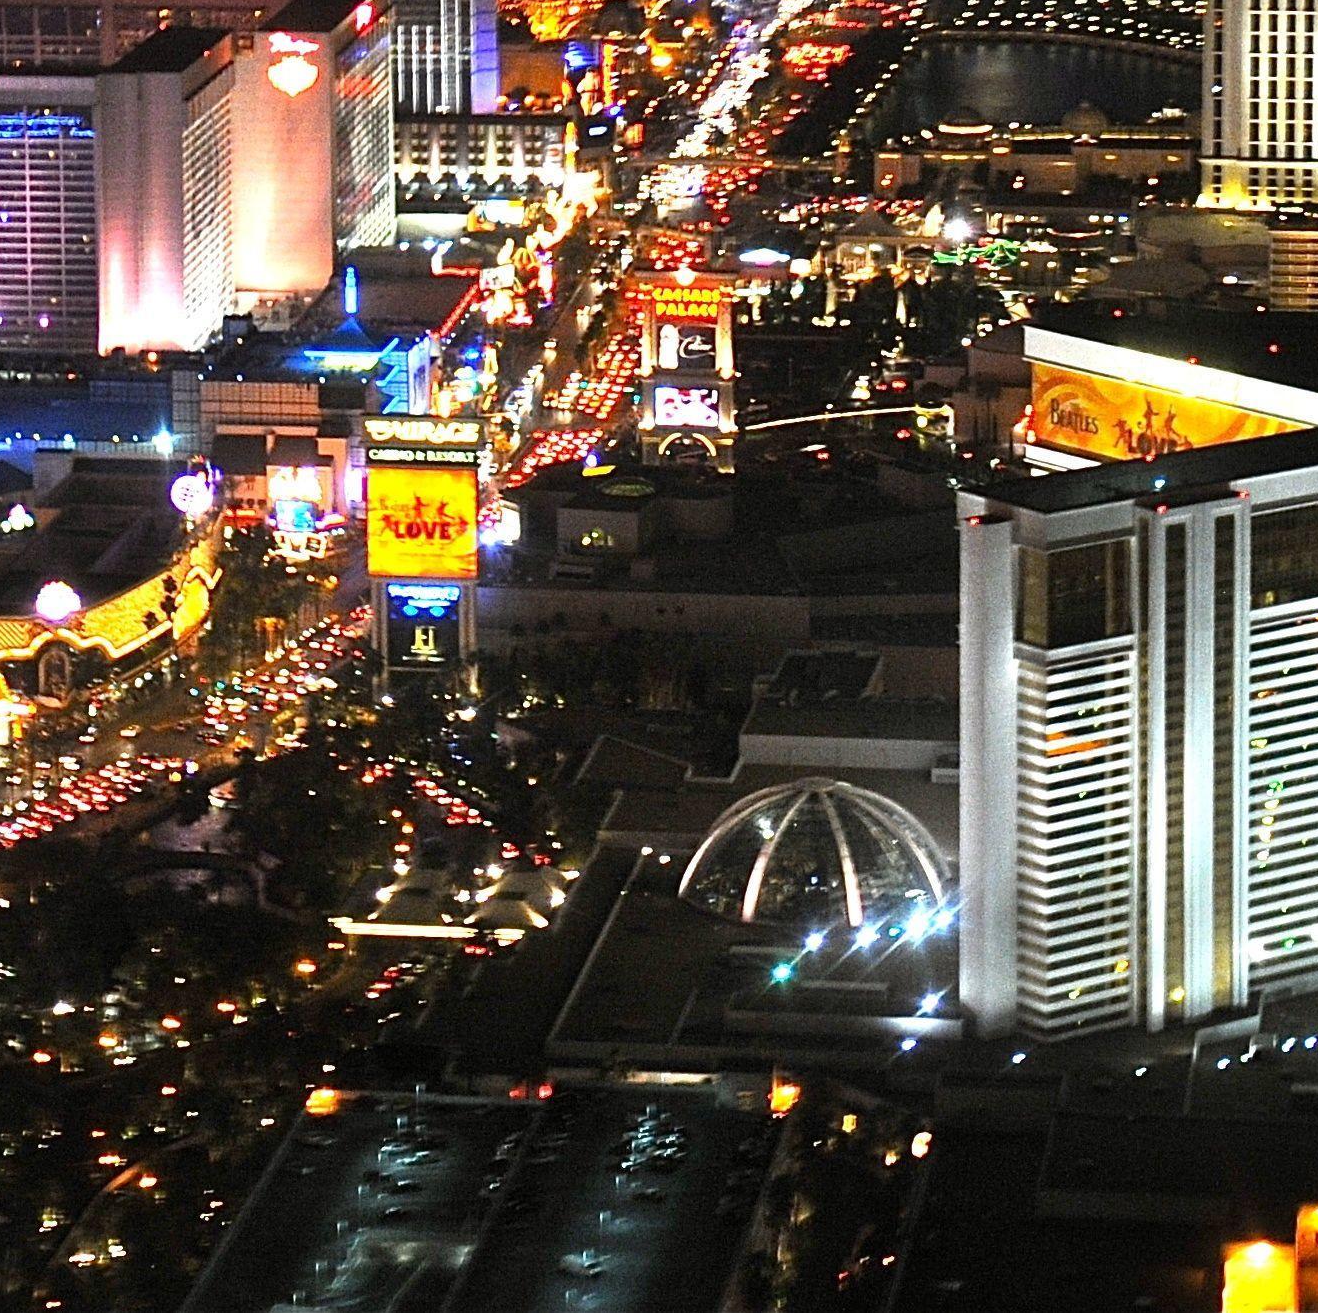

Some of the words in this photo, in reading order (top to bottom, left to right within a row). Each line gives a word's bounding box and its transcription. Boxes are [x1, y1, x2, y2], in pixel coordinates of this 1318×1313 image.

[652, 288, 721, 302] CAESARS
[655, 302, 718, 317] PALACE
[1050, 398, 1099, 434] BEATLES
[394, 521, 452, 540] LOVE
